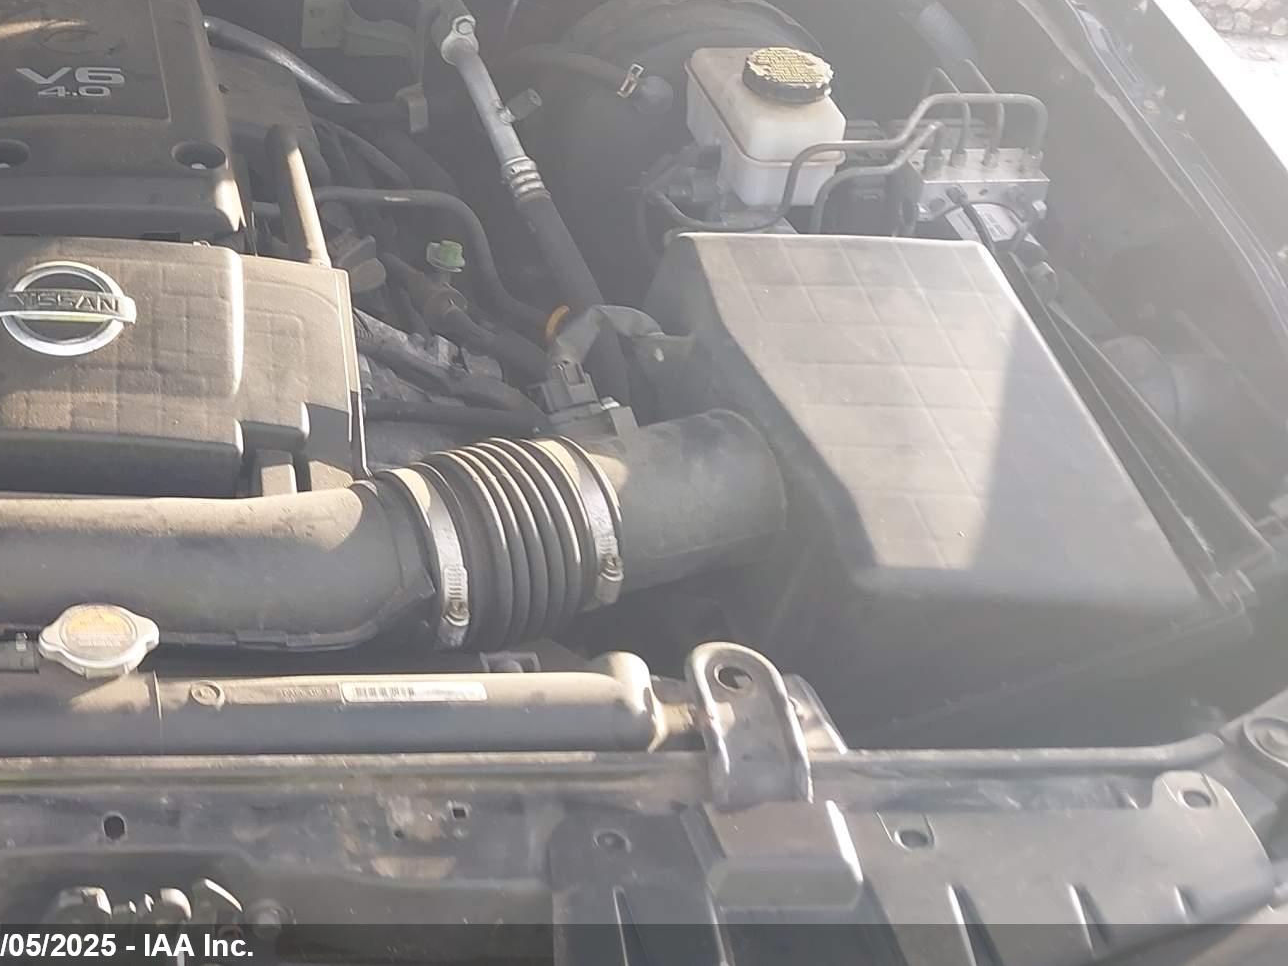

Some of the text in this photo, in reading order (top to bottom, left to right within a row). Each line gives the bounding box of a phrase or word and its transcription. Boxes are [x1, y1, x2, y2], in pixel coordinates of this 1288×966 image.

[16, 67, 125, 85] V6
[38, 86, 111, 97] 4.0
[8, 294, 120, 313] NISSAN
